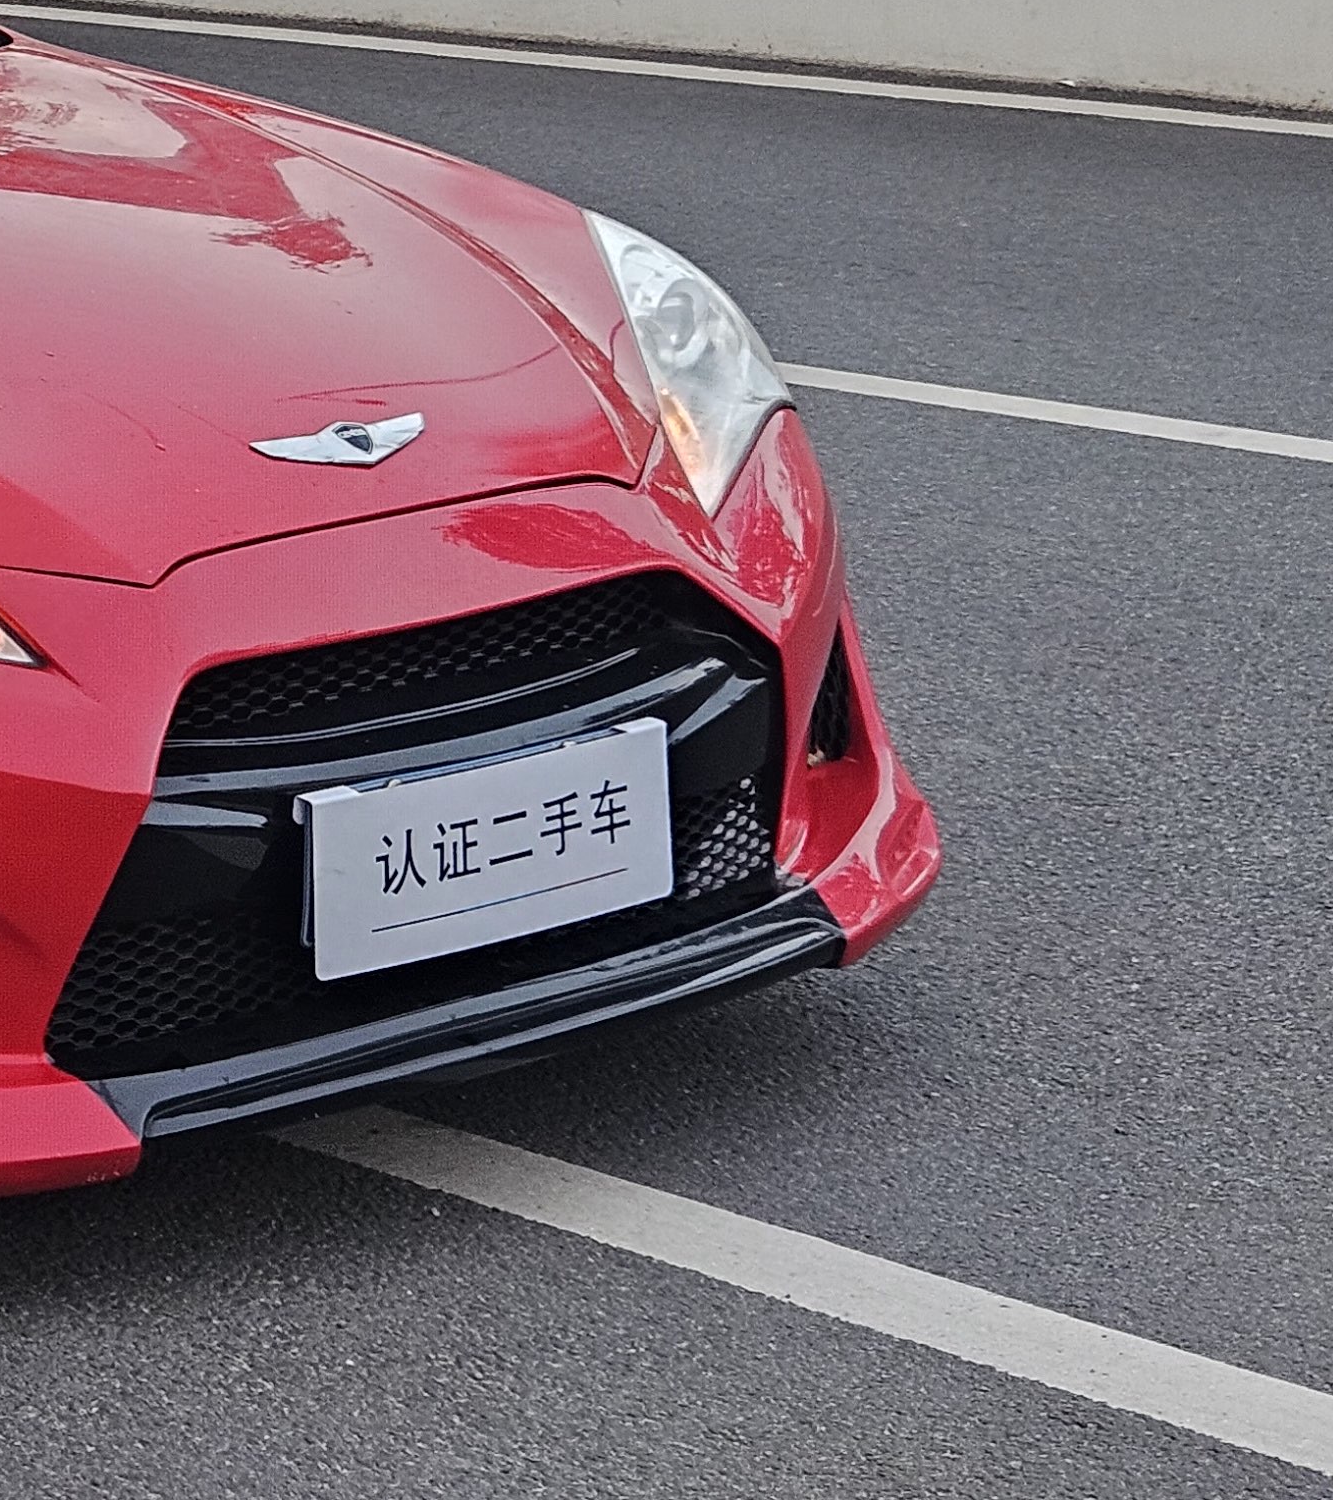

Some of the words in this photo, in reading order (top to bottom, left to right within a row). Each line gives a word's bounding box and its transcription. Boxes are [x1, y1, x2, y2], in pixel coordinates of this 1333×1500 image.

[375, 779, 631, 895] 认证二手车
